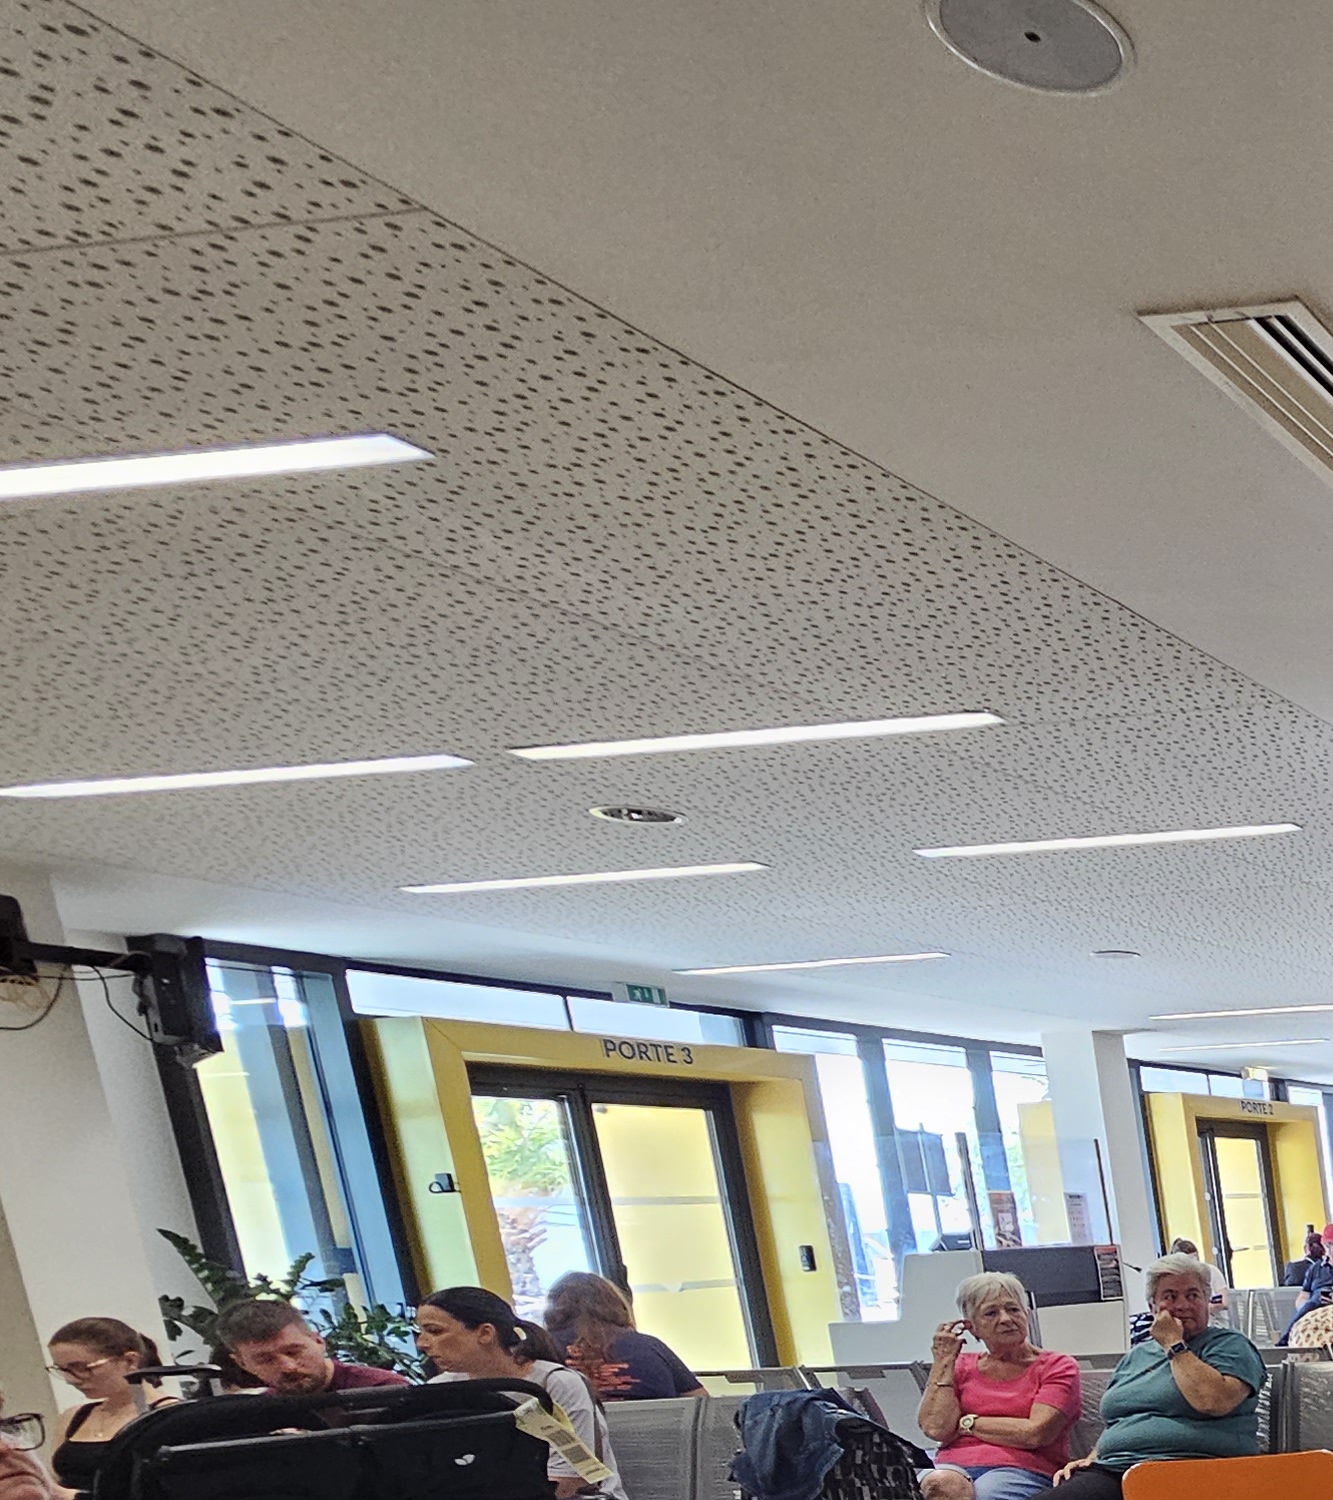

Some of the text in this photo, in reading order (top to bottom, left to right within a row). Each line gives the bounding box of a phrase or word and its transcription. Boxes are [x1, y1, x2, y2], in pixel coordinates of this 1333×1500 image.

[602, 1039, 693, 1064] PORTE 3
[1240, 1100, 1267, 1115] PORTE
